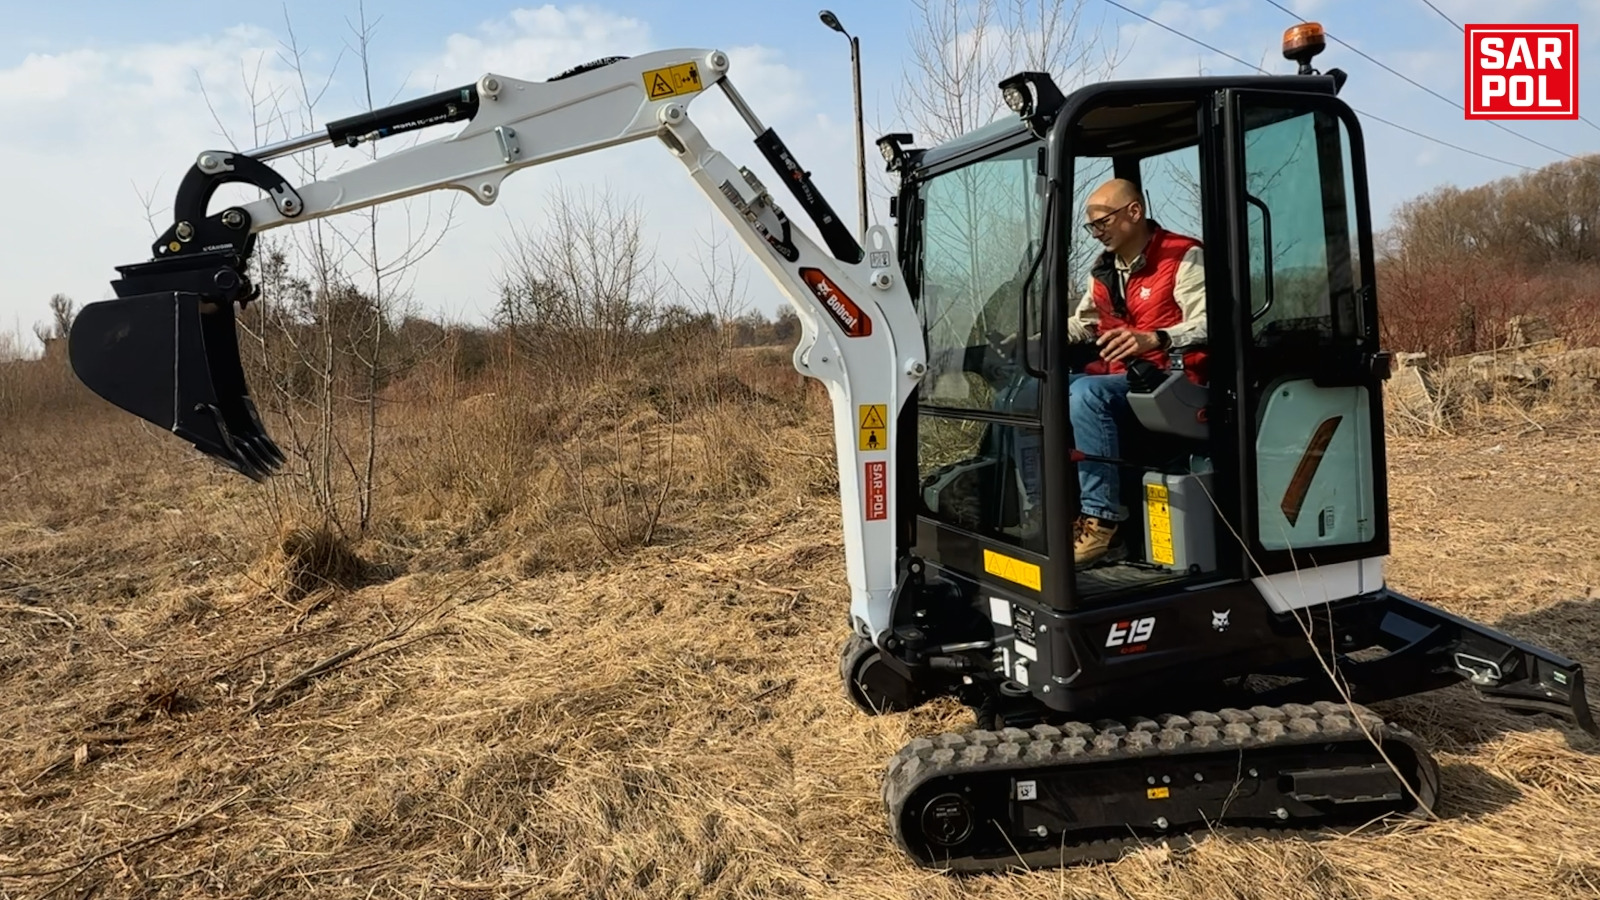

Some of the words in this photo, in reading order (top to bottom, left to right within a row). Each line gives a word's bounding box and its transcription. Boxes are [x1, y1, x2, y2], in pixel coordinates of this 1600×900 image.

[827, 295, 858, 328] Bobcat
[873, 463, 884, 518] SAR-POL
[1105, 617, 1156, 647] E19
